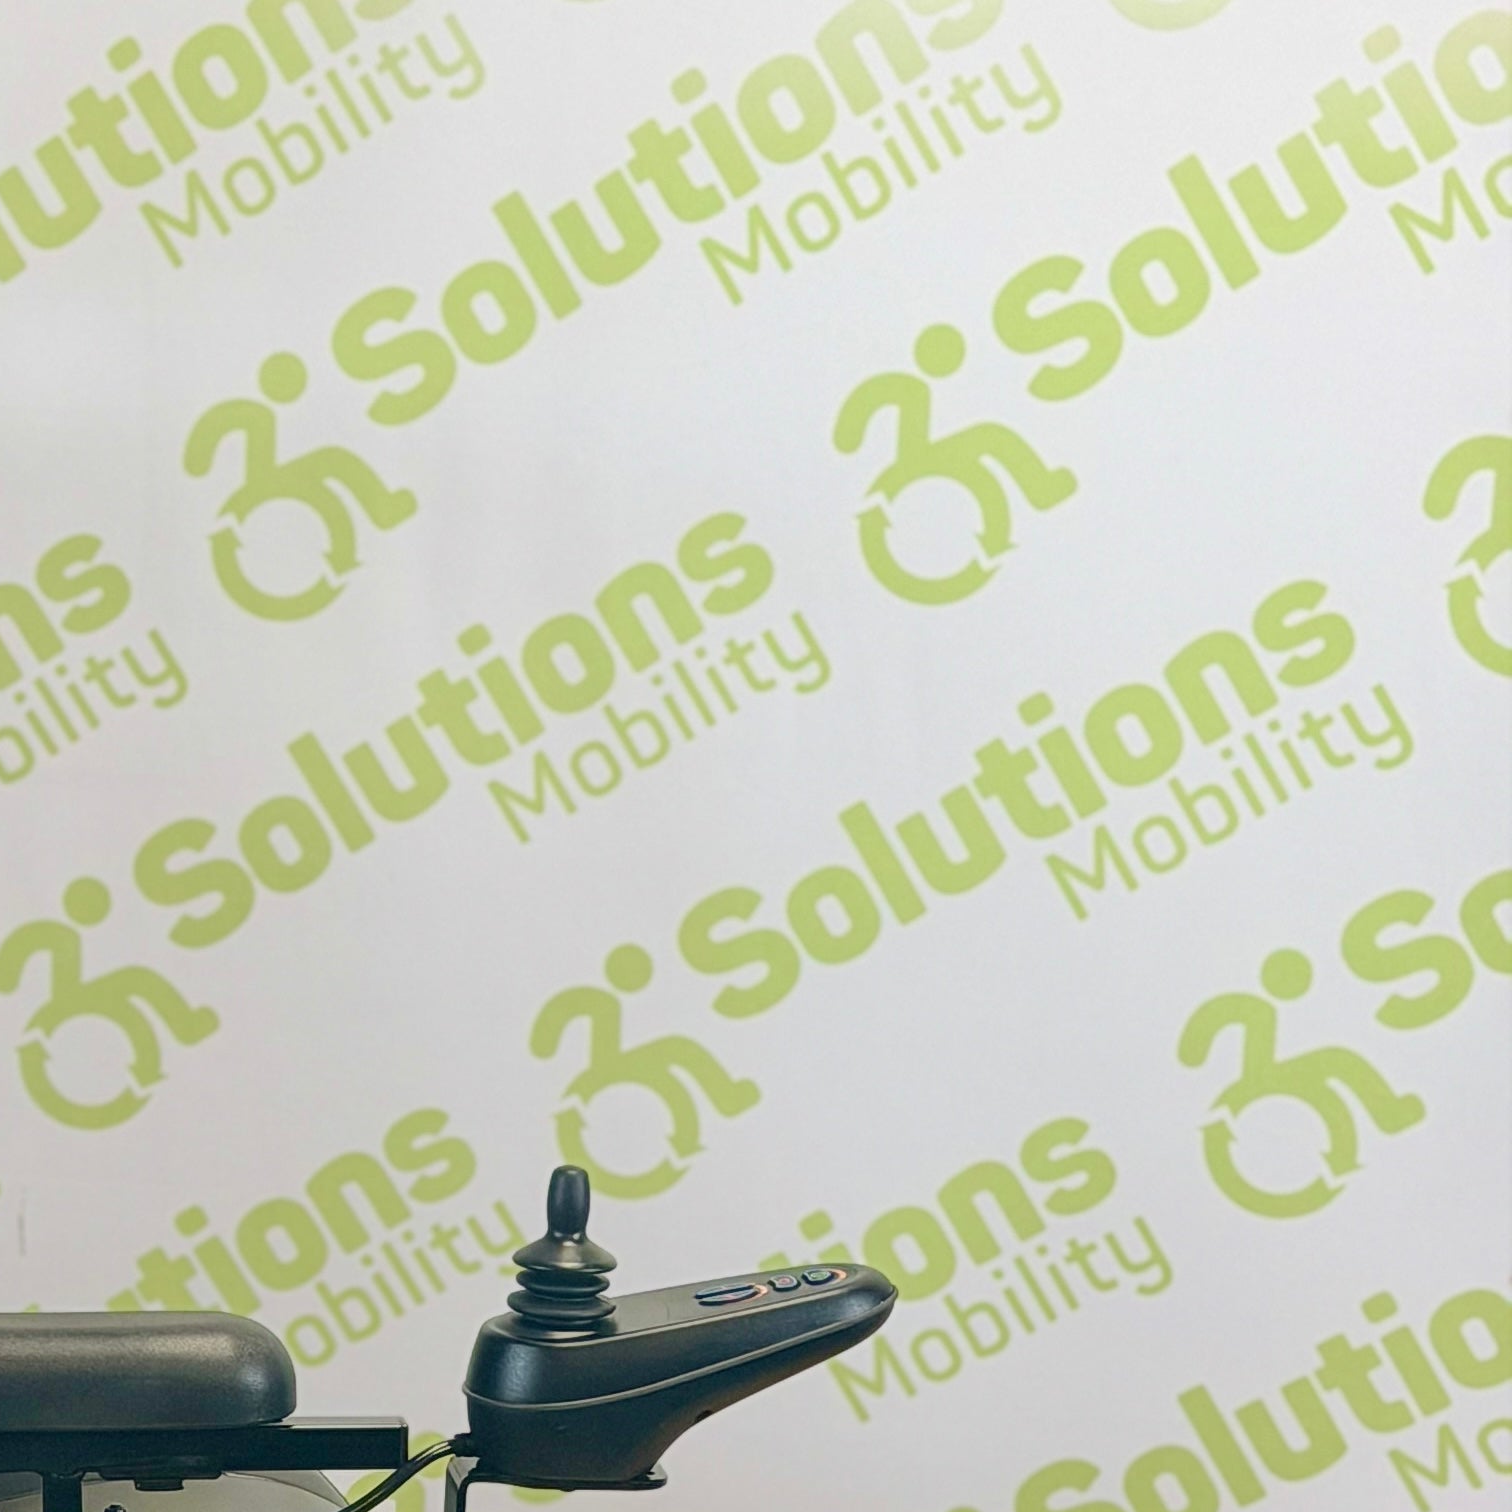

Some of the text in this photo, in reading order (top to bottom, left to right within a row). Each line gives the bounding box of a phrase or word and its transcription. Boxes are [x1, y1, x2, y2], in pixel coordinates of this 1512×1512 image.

[137, 15, 485, 269] Mobility
[698, 45, 1062, 306] Mobility
[990, 11, 1512, 404] Solutio
[130, 510, 775, 951] Solutions
[486, 611, 833, 845] Mobility
[675, 578, 1357, 1021] Solutions
[1044, 684, 1415, 922] Mobility
[282, 1199, 528, 1370] obility
[826, 1216, 1174, 1424] Mobility
